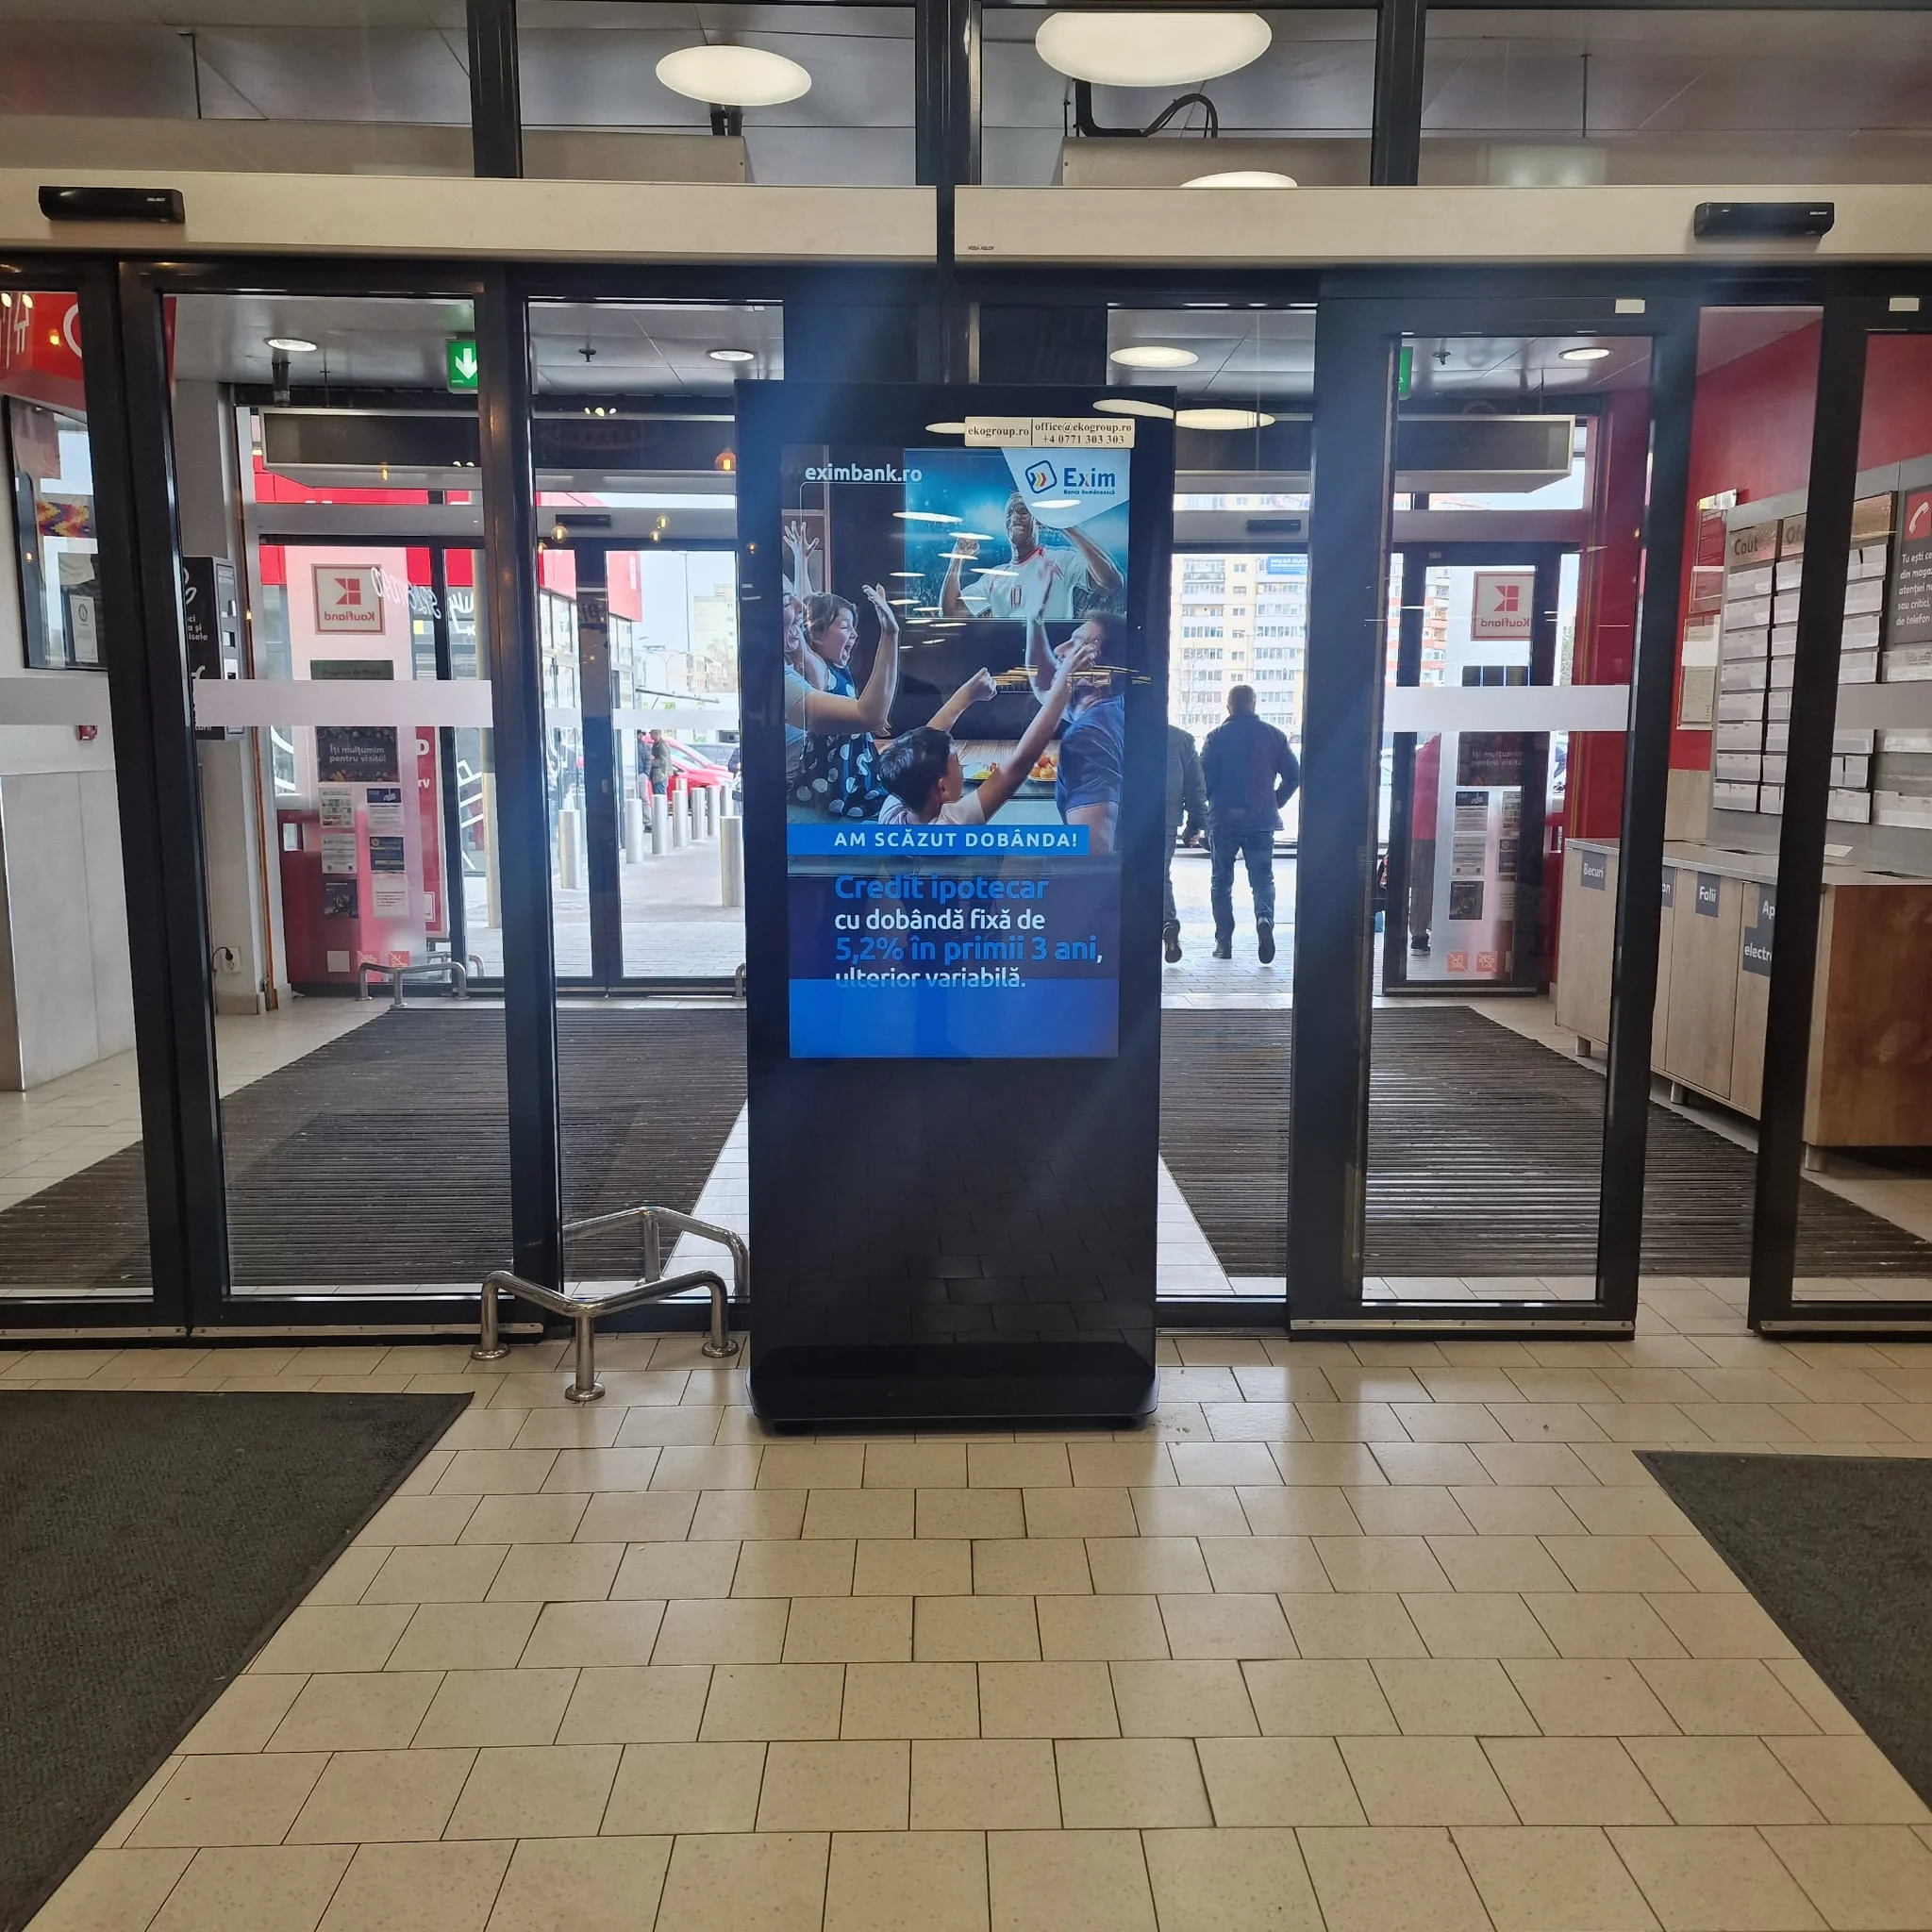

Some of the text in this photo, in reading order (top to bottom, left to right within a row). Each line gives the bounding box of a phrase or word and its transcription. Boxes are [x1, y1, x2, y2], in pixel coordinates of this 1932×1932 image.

[968, 426, 1029, 438] ekogroup.ro
[1035, 422, 1132, 433] office@ekogroup.ro
[1042, 435, 1124, 444] +4 0771 303 303
[805, 462, 923, 482] eximbank.ro
[1063, 467, 1116, 488] Exim
[1734, 536, 1758, 556] Caut
[1901, 553, 1910, 564] Tu
[1900, 569, 1911, 579] din
[1897, 602, 1910, 610] sau
[1896, 613, 1931, 626] de telefon
[329, 755, 358, 763] pentru
[834, 828, 1077, 847] AM SCĂZUT DOBÂNDA!
[1583, 862, 1605, 878] Becuri
[835, 874, 1049, 905] Credit ipotecar
[1699, 885, 1717, 904] Folii
[834, 908, 1046, 930] cu dobândă fixă de
[836, 934, 1103, 965] 5,2% în primii 3 ani,
[835, 966, 1026, 988] ulterior variabilă.
